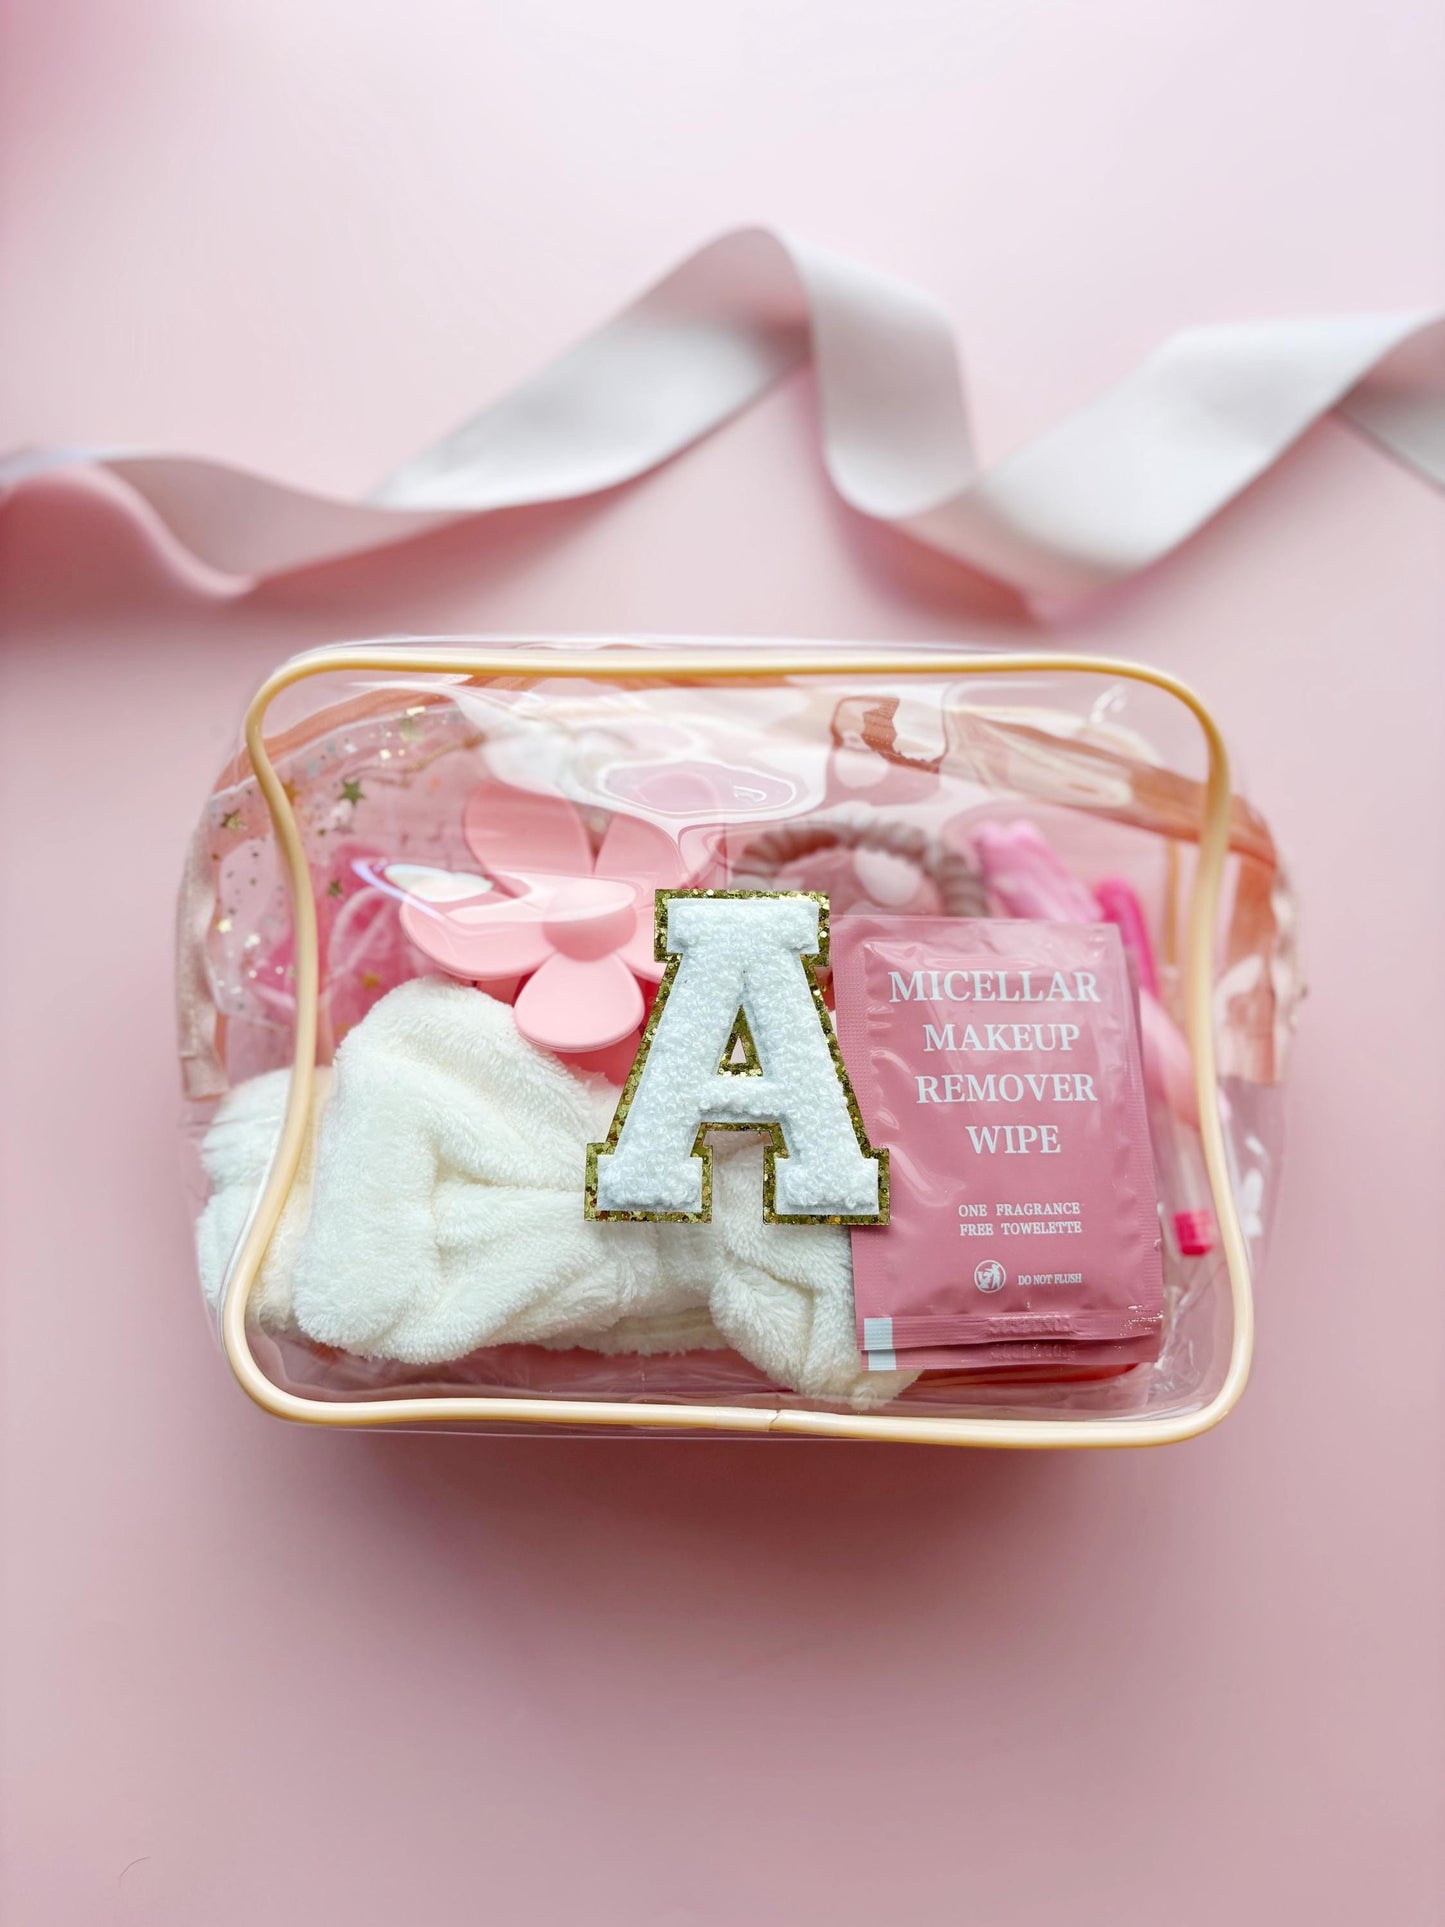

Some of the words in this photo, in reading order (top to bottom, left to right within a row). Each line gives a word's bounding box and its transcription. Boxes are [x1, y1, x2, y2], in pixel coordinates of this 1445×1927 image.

[888, 970, 1101, 1003] MICELLAR
[923, 1024, 1080, 1052] MAKEUP
[584, 889, 889, 1225] A
[914, 1073, 1098, 1104] REMOVER
[966, 1125, 1061, 1155] WIPE
[958, 1204, 988, 1217] ONE
[996, 1202, 1080, 1216] FRAGRANCE
[960, 1223, 994, 1236] FREE
[1001, 1221, 1082, 1235] TOWELETTE
[1018, 1275, 1031, 1285] DO
[1034, 1274, 1053, 1285] NOT
[1054, 1273, 1082, 1284] FLUSH
